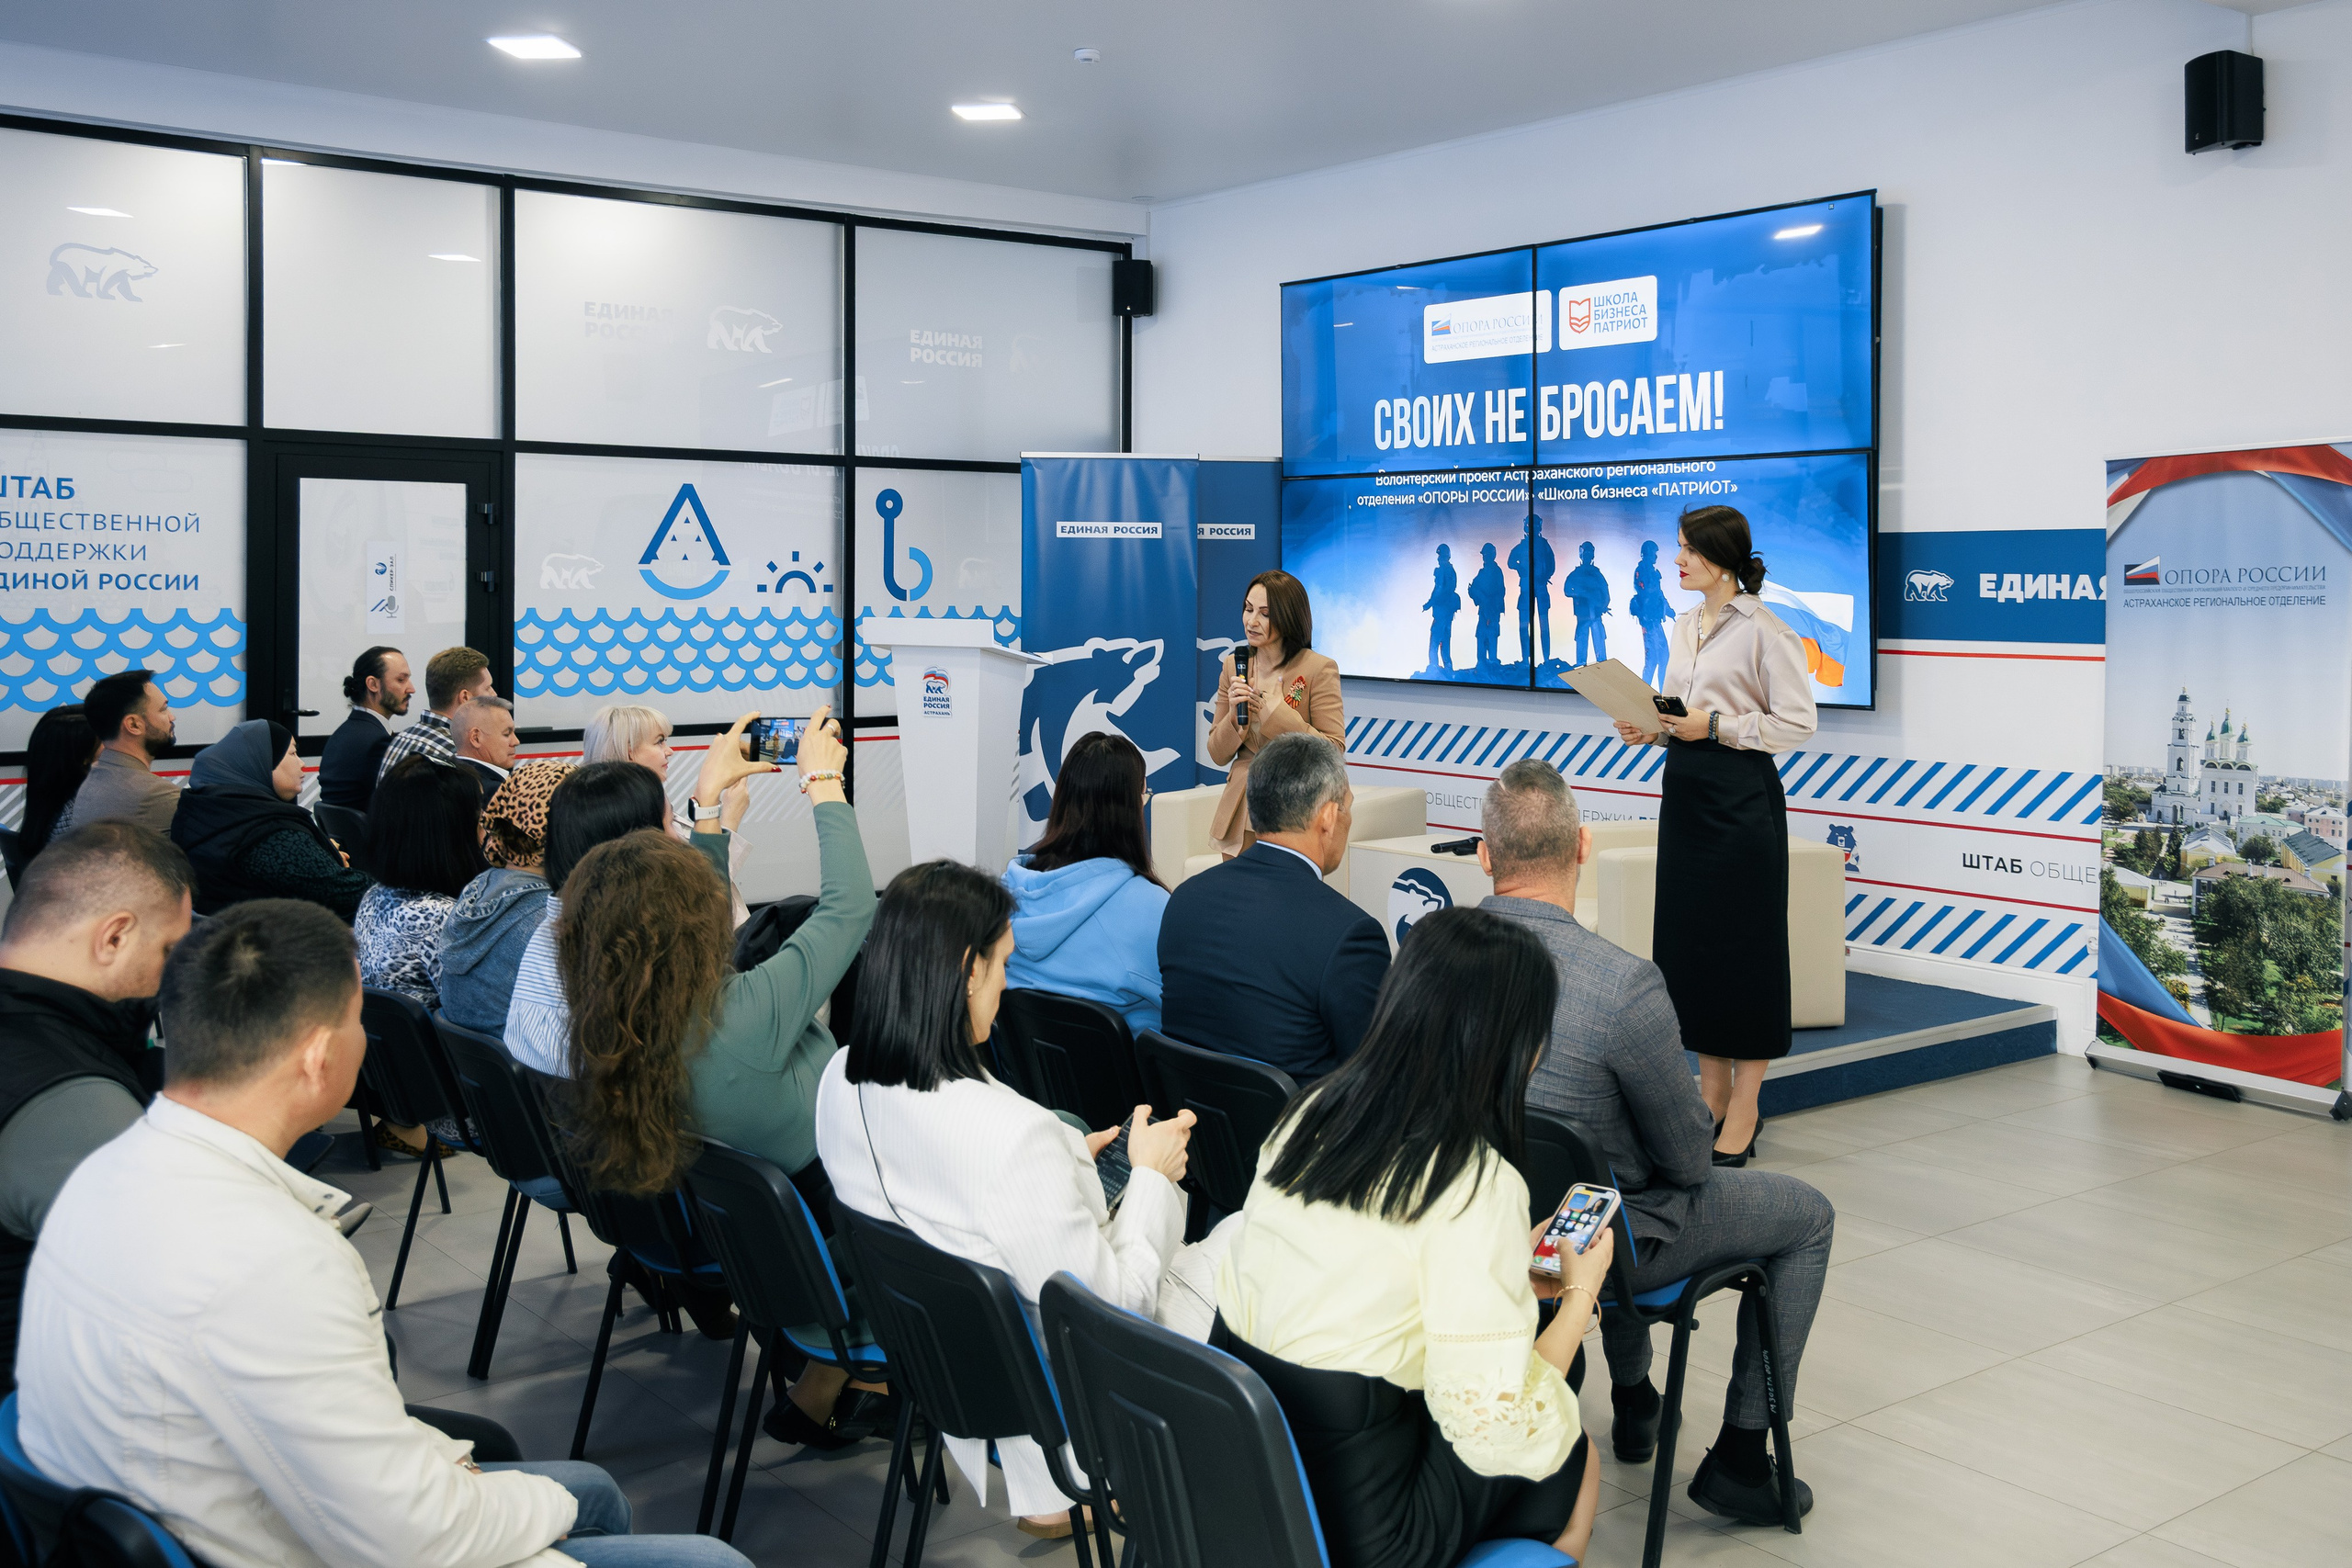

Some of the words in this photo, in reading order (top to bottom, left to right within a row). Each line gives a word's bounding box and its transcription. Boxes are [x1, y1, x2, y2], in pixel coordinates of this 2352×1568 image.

[1593, 292, 1638, 308] ШКОЛА
[1594, 304, 1646, 321] БИЗНЕСА
[1453, 321, 1490, 334] ОПОРА
[1593, 317, 1648, 333] ПАТРИОТ
[910, 330, 982, 349] ЕДИНАЯ
[910, 347, 982, 367] РОССИЯ
[1374, 392, 1476, 450] СВОИХ
[1485, 388, 1527, 444] НЕ
[1540, 370, 1724, 441] БРОСАЕМ!
[1459, 471, 1502, 486] проект
[1607, 461, 1716, 479] регионального
[0, 475, 75, 500] ТАБ
[1357, 493, 1415, 507] отделения
[1418, 490, 1469, 504] «ОПОРЫ
[1537, 487, 1588, 501] «Школа
[1590, 484, 1648, 500] бизнеса
[1651, 479, 1738, 497] «ПАТРИОТ»
[0, 511, 200, 533] БЩЕСТВЕННОЙ
[1060, 525, 1108, 535] ЕДИНАЯ
[1114, 526, 1158, 535] РОССИЯ
[1209, 527, 1251, 536] РОССИЯ
[0, 541, 147, 562] ОДДЕРЖКИ
[98, 573, 199, 591] РОССИИ
[2165, 569, 2232, 585] ОПОРА
[2237, 566, 2326, 583] РОССИИ
[2123, 598, 2190, 607] АСТРАХАНСКОЕ
[2193, 597, 2267, 606] РЕГИОНАЛЬНОЕ
[2268, 595, 2326, 607] ОТДЕЛЕНИЕ
[1962, 852, 2023, 874] ШТАБ
[2030, 861, 2101, 885] ОБЩЕ
